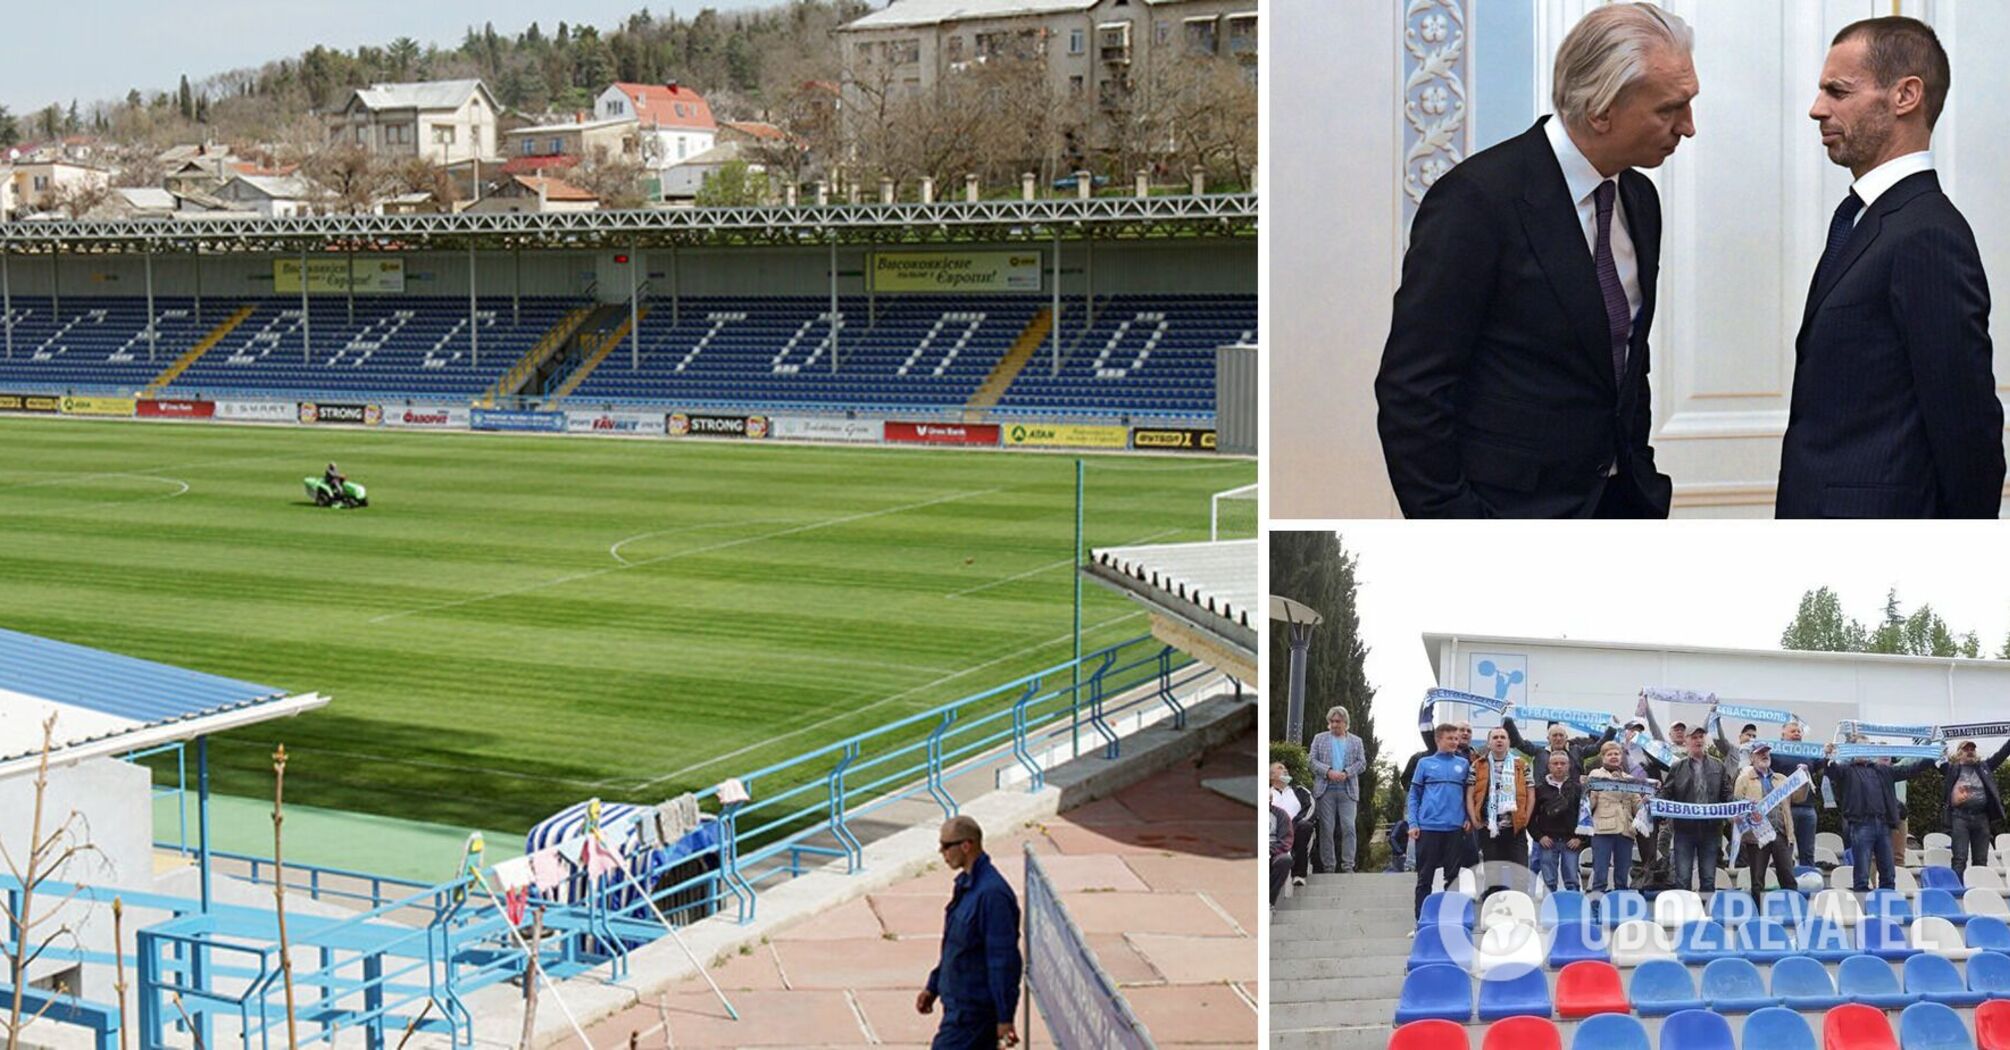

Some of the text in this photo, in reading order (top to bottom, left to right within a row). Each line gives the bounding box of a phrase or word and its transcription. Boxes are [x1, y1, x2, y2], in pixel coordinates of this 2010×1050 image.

[319, 407, 363, 419] STRONG
[691, 419, 744, 432] STRONG
[1942, 725, 2009, 738] ЕВАСТОПОЛЬ
